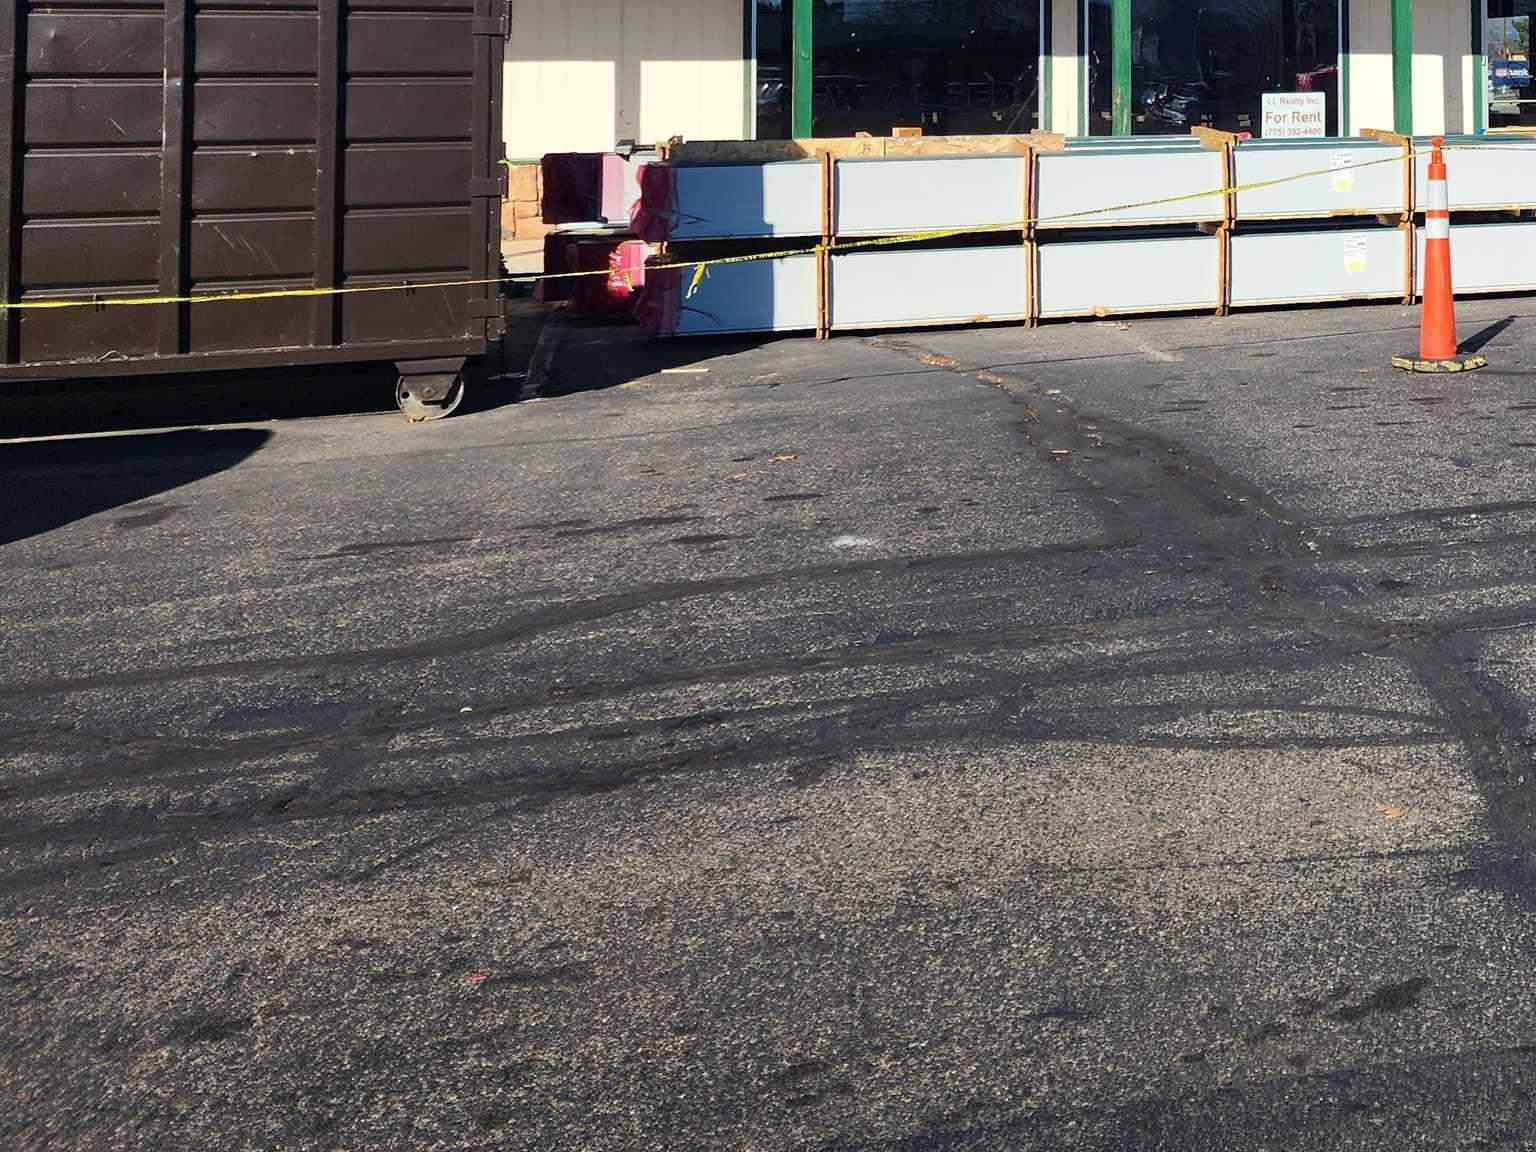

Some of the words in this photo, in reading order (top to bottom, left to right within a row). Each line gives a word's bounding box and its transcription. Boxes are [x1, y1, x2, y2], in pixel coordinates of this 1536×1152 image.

[1280, 96, 1305, 106] Realty
[1306, 96, 1321, 105] Inc.
[1265, 112, 1288, 124] For
[1292, 111, 1322, 123] Rent
